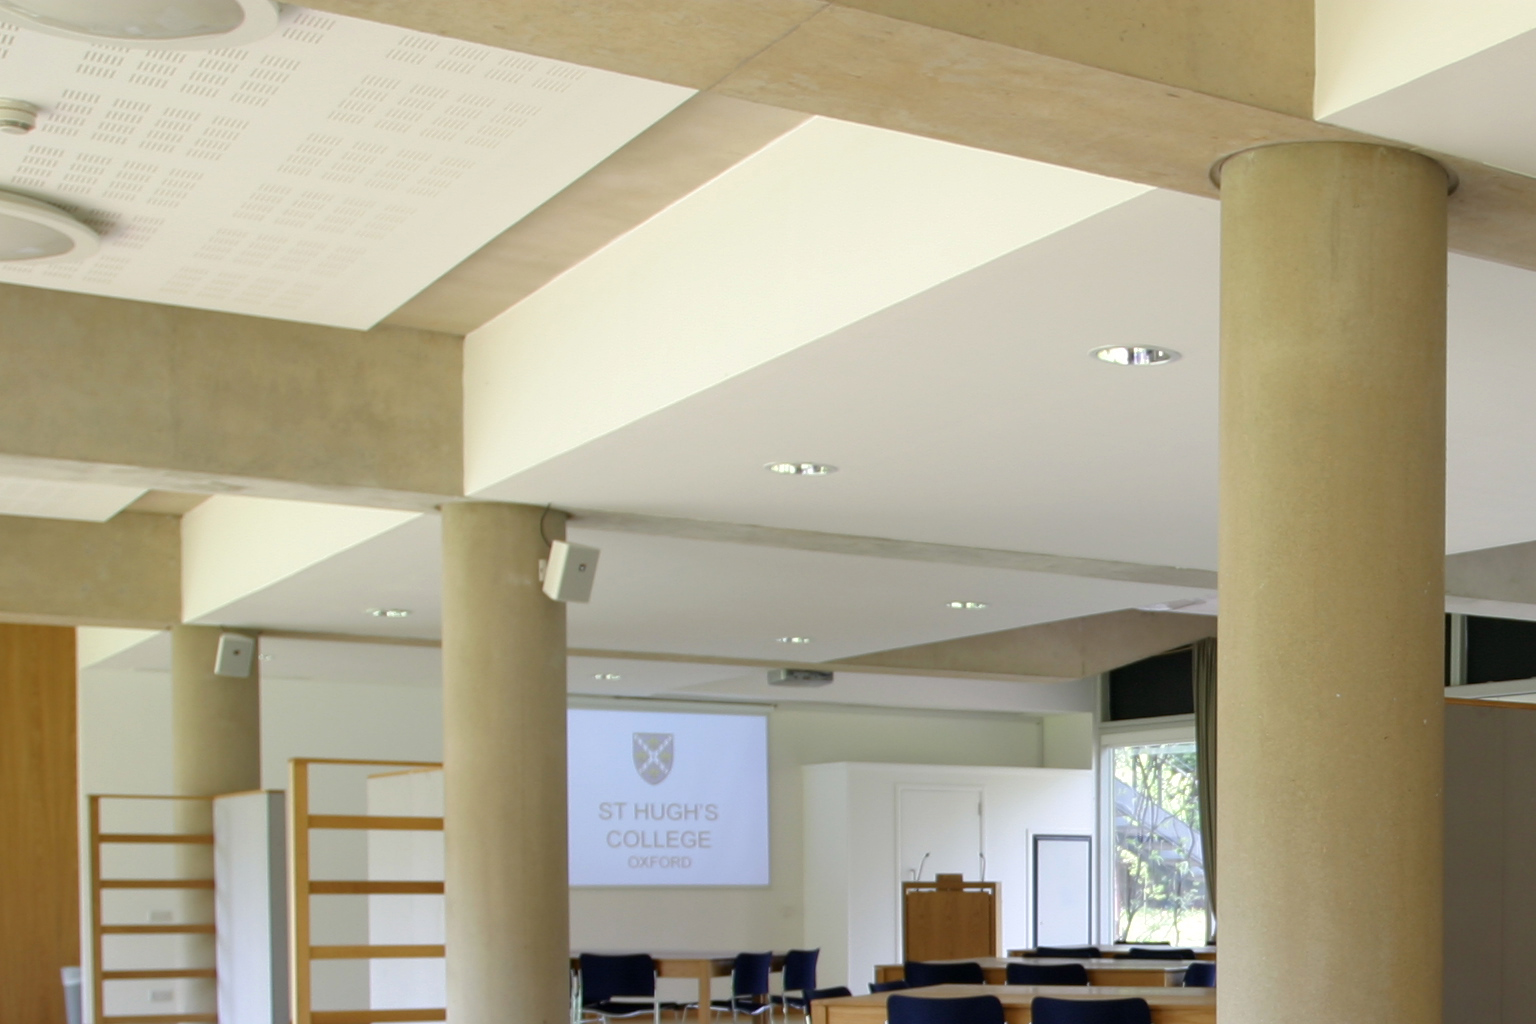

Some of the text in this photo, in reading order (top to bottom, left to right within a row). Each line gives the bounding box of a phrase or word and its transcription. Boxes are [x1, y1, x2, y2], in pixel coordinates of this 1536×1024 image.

[598, 802, 719, 821] ST HUGH'S
[606, 830, 712, 848] COLLEGE
[627, 856, 692, 869] OXFORD
